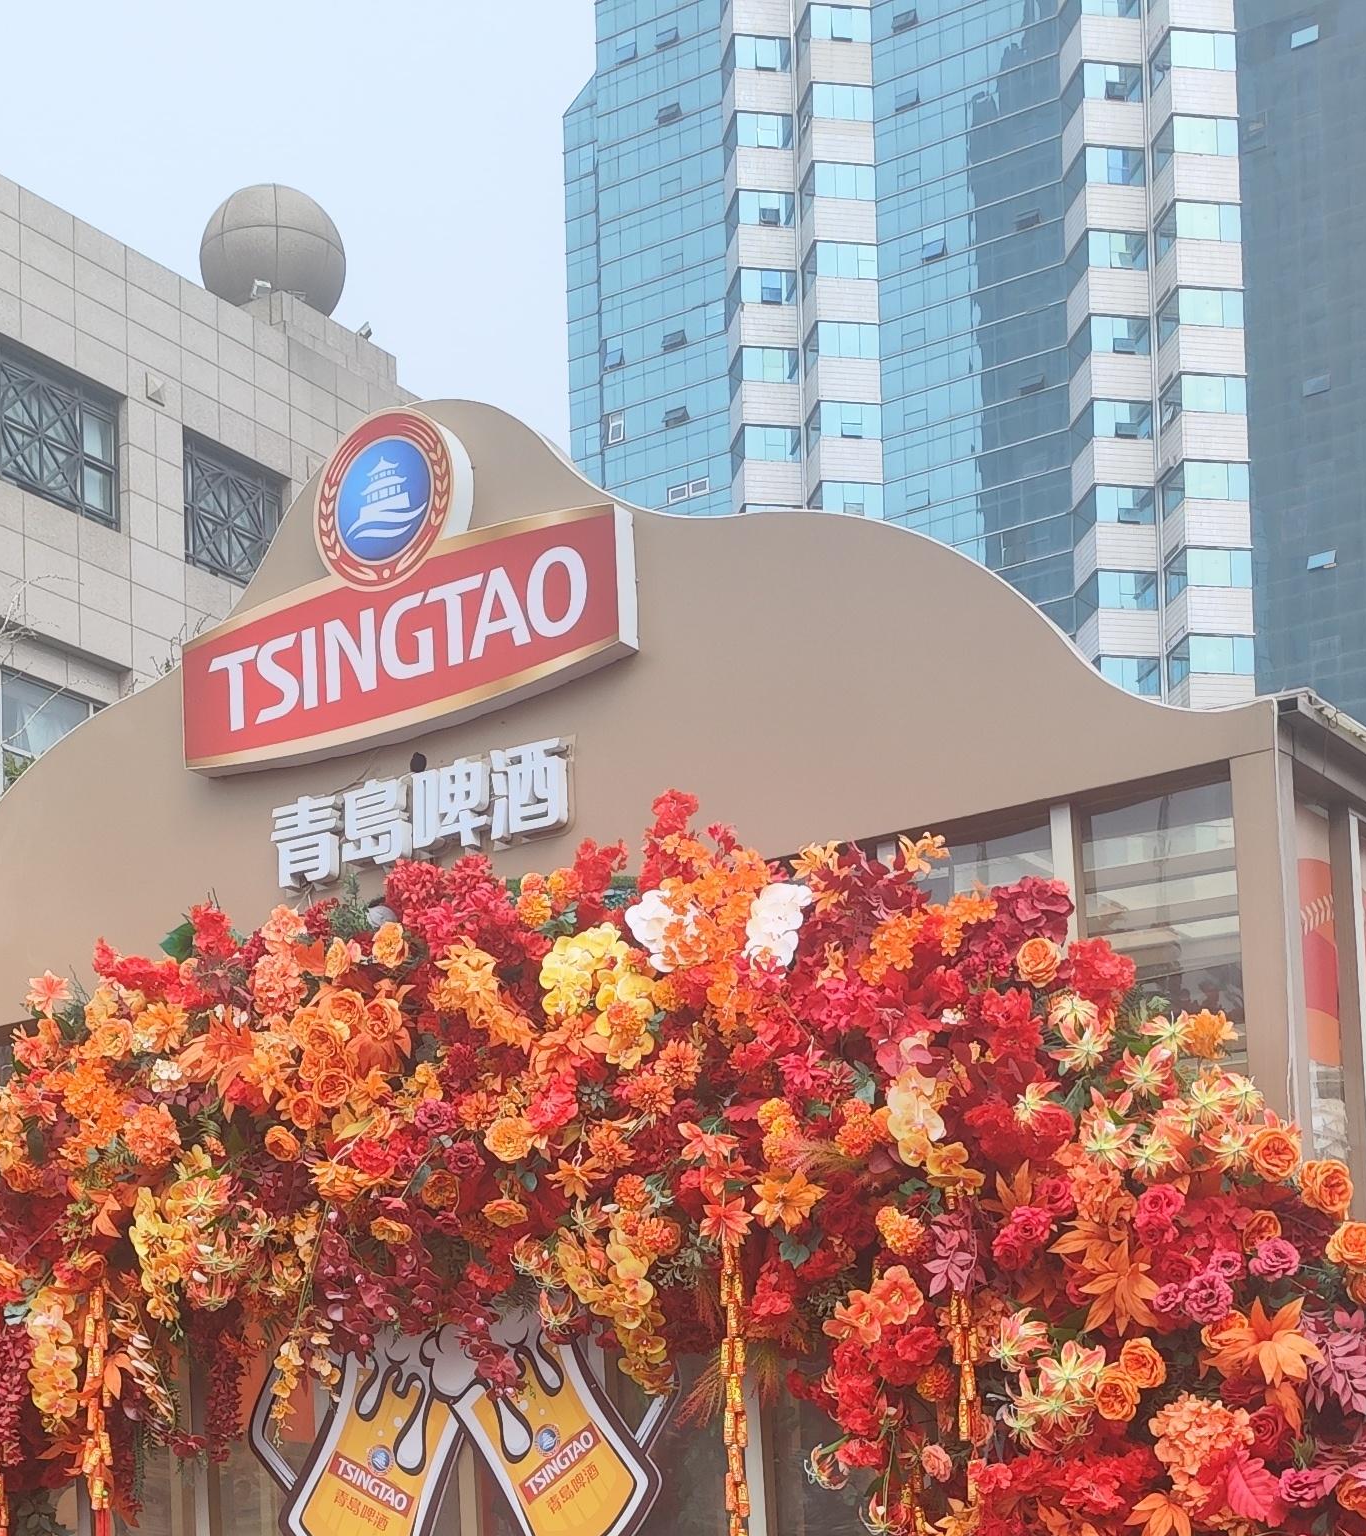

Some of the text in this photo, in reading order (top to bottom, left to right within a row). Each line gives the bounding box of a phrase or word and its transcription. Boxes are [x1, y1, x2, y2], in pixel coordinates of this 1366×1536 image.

[208, 545, 588, 731] TSINGTAO
[337, 1457, 408, 1511] TSINGTAO
[523, 1430, 594, 1495] TSINGTAO
